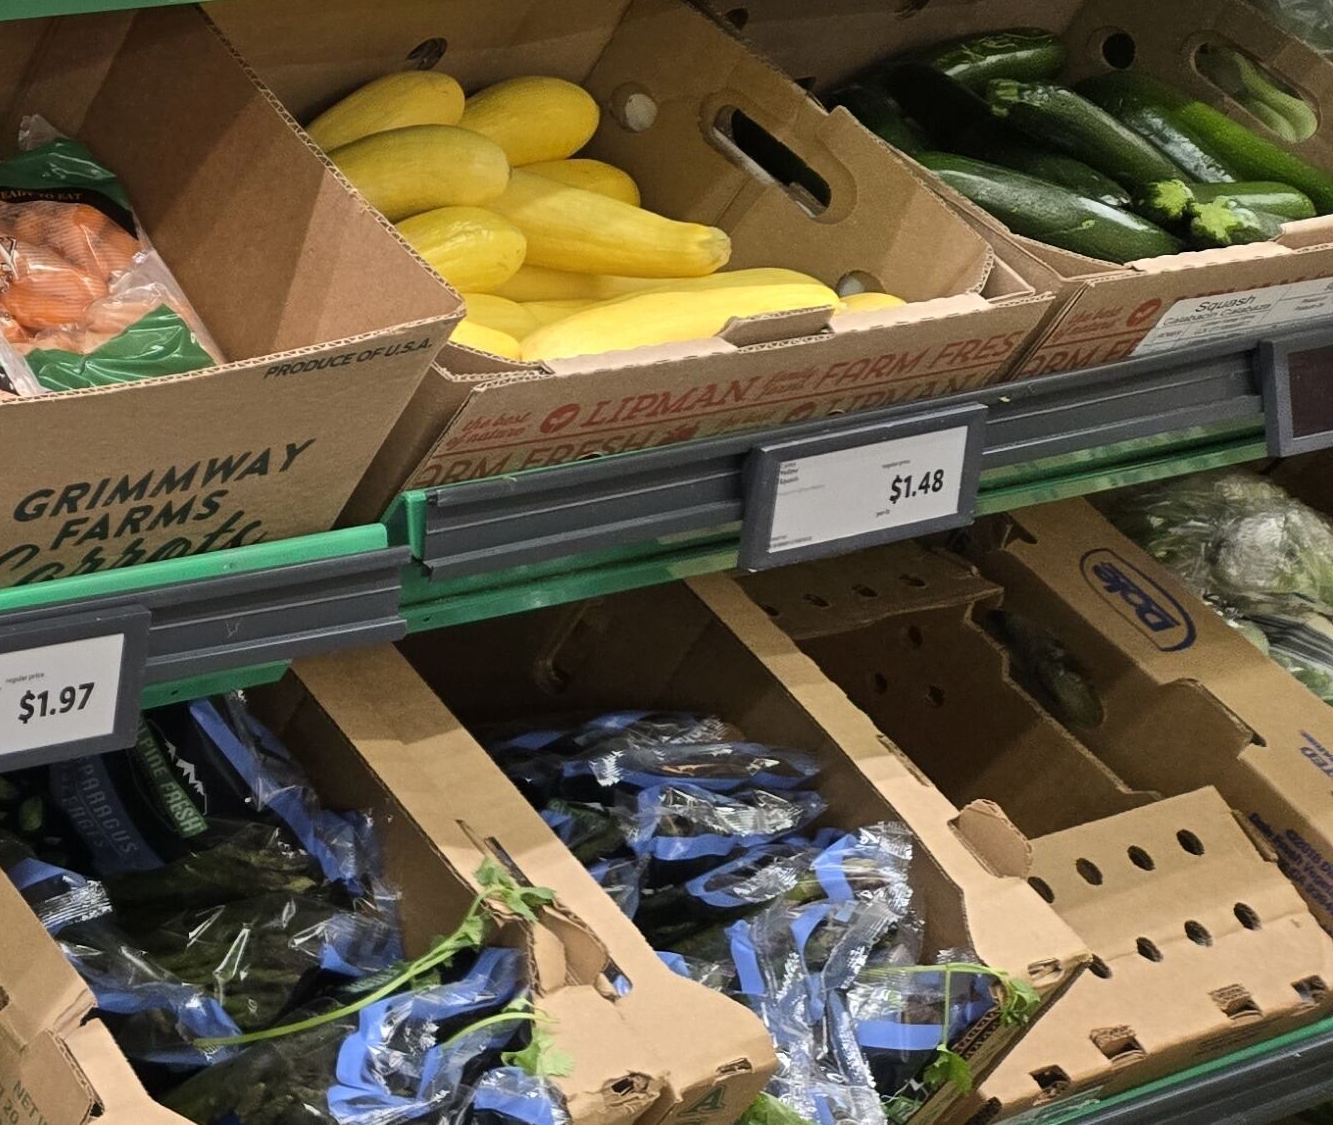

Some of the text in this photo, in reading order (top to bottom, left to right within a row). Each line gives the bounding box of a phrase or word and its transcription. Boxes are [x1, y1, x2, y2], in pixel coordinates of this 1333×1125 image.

[1195, 295, 1257, 313] Squash
[263, 337, 435, 380] PRODUCE OF U.S.A.
[579, 376, 760, 429] LIPMAN
[813, 347, 930, 390] FARM
[925, 330, 1025, 368] FRES
[517, 427, 657, 472] FRESH
[13, 437, 318, 523] GRIMMWAY
[889, 469, 945, 504] $1.48
[50, 488, 232, 552] FARMS
[5, 671, 45, 686] regular price
[18, 682, 95, 725] $1.97
[158, 780, 205, 836] FRESH
[12, 1079, 39, 1118] NET
